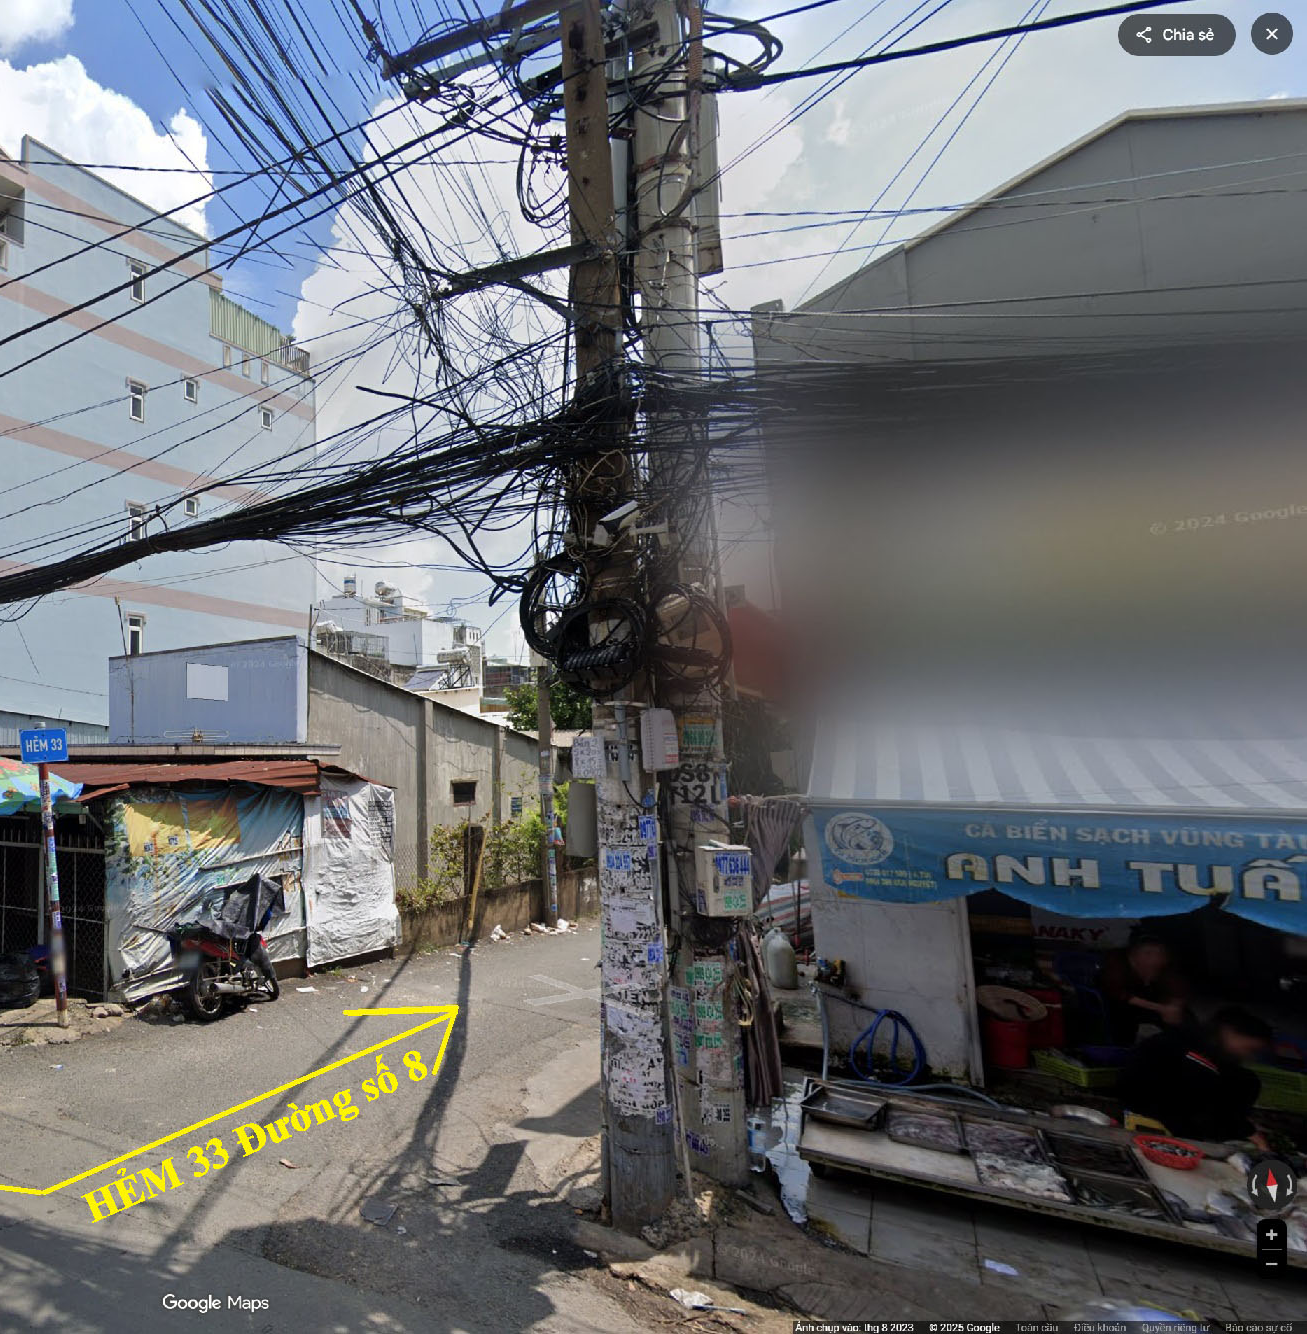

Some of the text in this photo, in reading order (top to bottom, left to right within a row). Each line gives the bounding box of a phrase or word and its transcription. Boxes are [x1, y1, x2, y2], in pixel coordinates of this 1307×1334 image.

[51, 738, 63, 751] 33
[1006, 819, 1067, 841] BIỂN
[1075, 828, 1150, 846] SẠCH
[1160, 827, 1245, 848] VŨNG
[946, 852, 1099, 888] ANH
